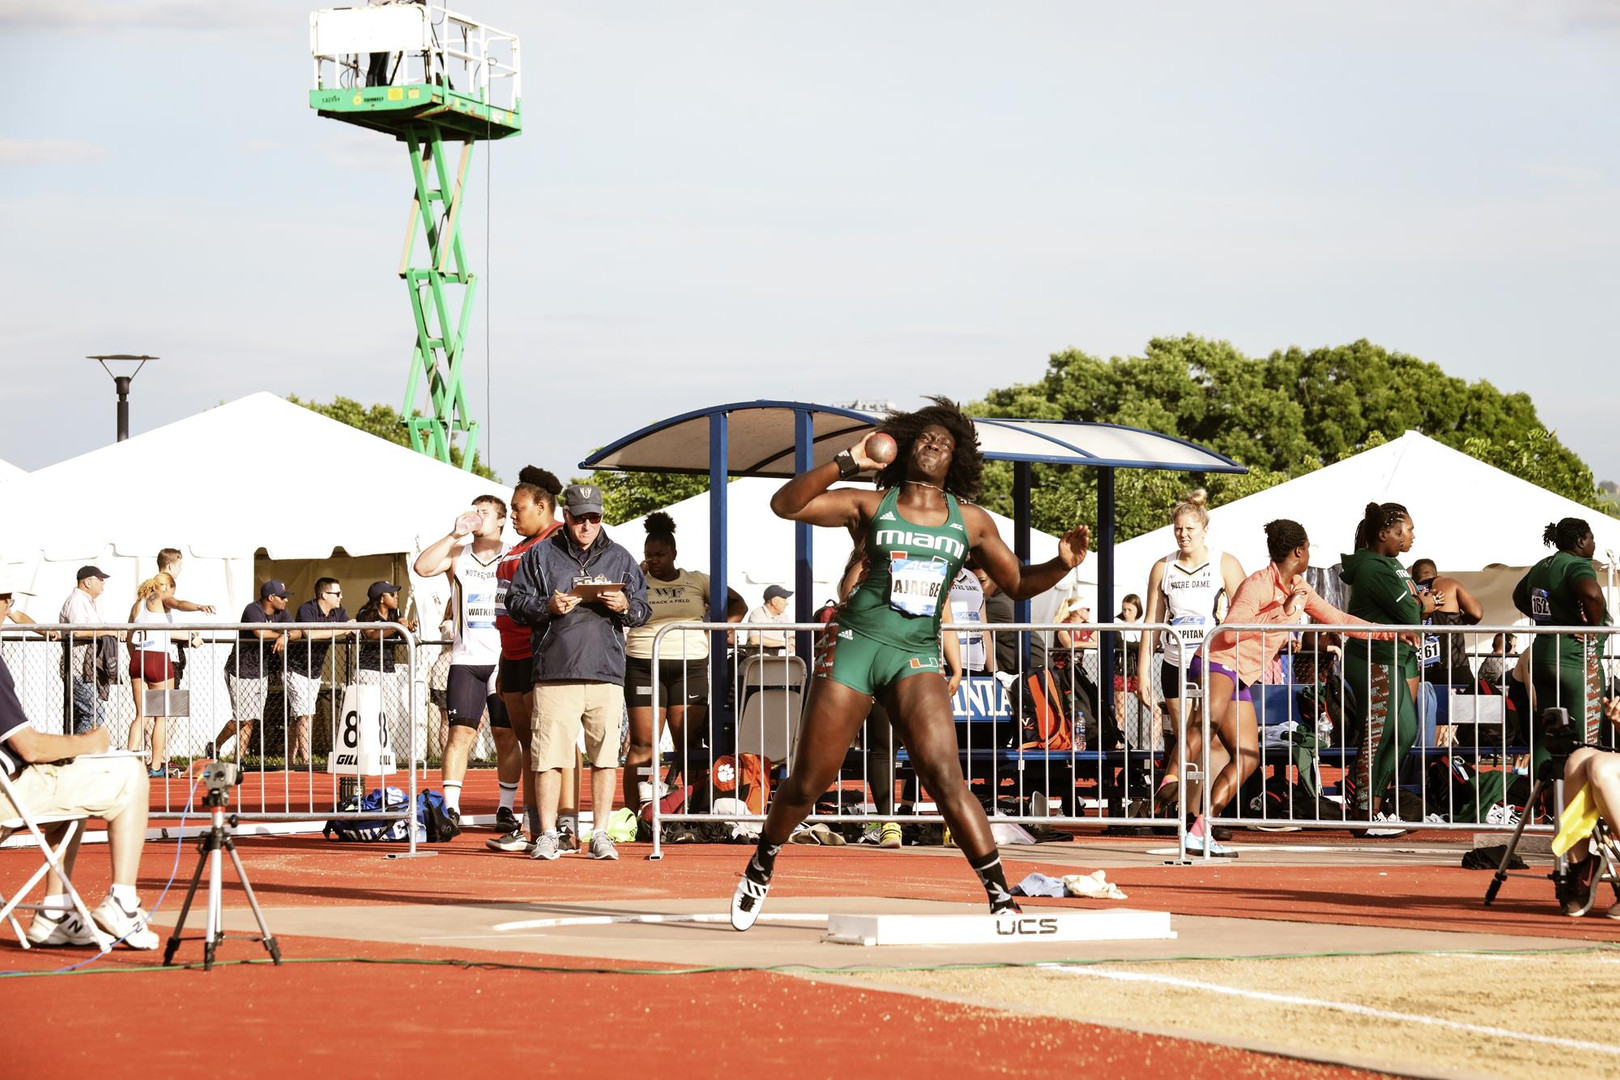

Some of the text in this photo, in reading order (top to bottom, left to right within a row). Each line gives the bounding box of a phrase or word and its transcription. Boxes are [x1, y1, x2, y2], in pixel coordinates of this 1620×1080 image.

[893, 579, 941, 598] AJAGBE
[1192, 580, 1210, 588] DAME
[1533, 597, 1549, 613] 162
[343, 710, 361, 748] 8
[996, 918, 1058, 935] UCS
